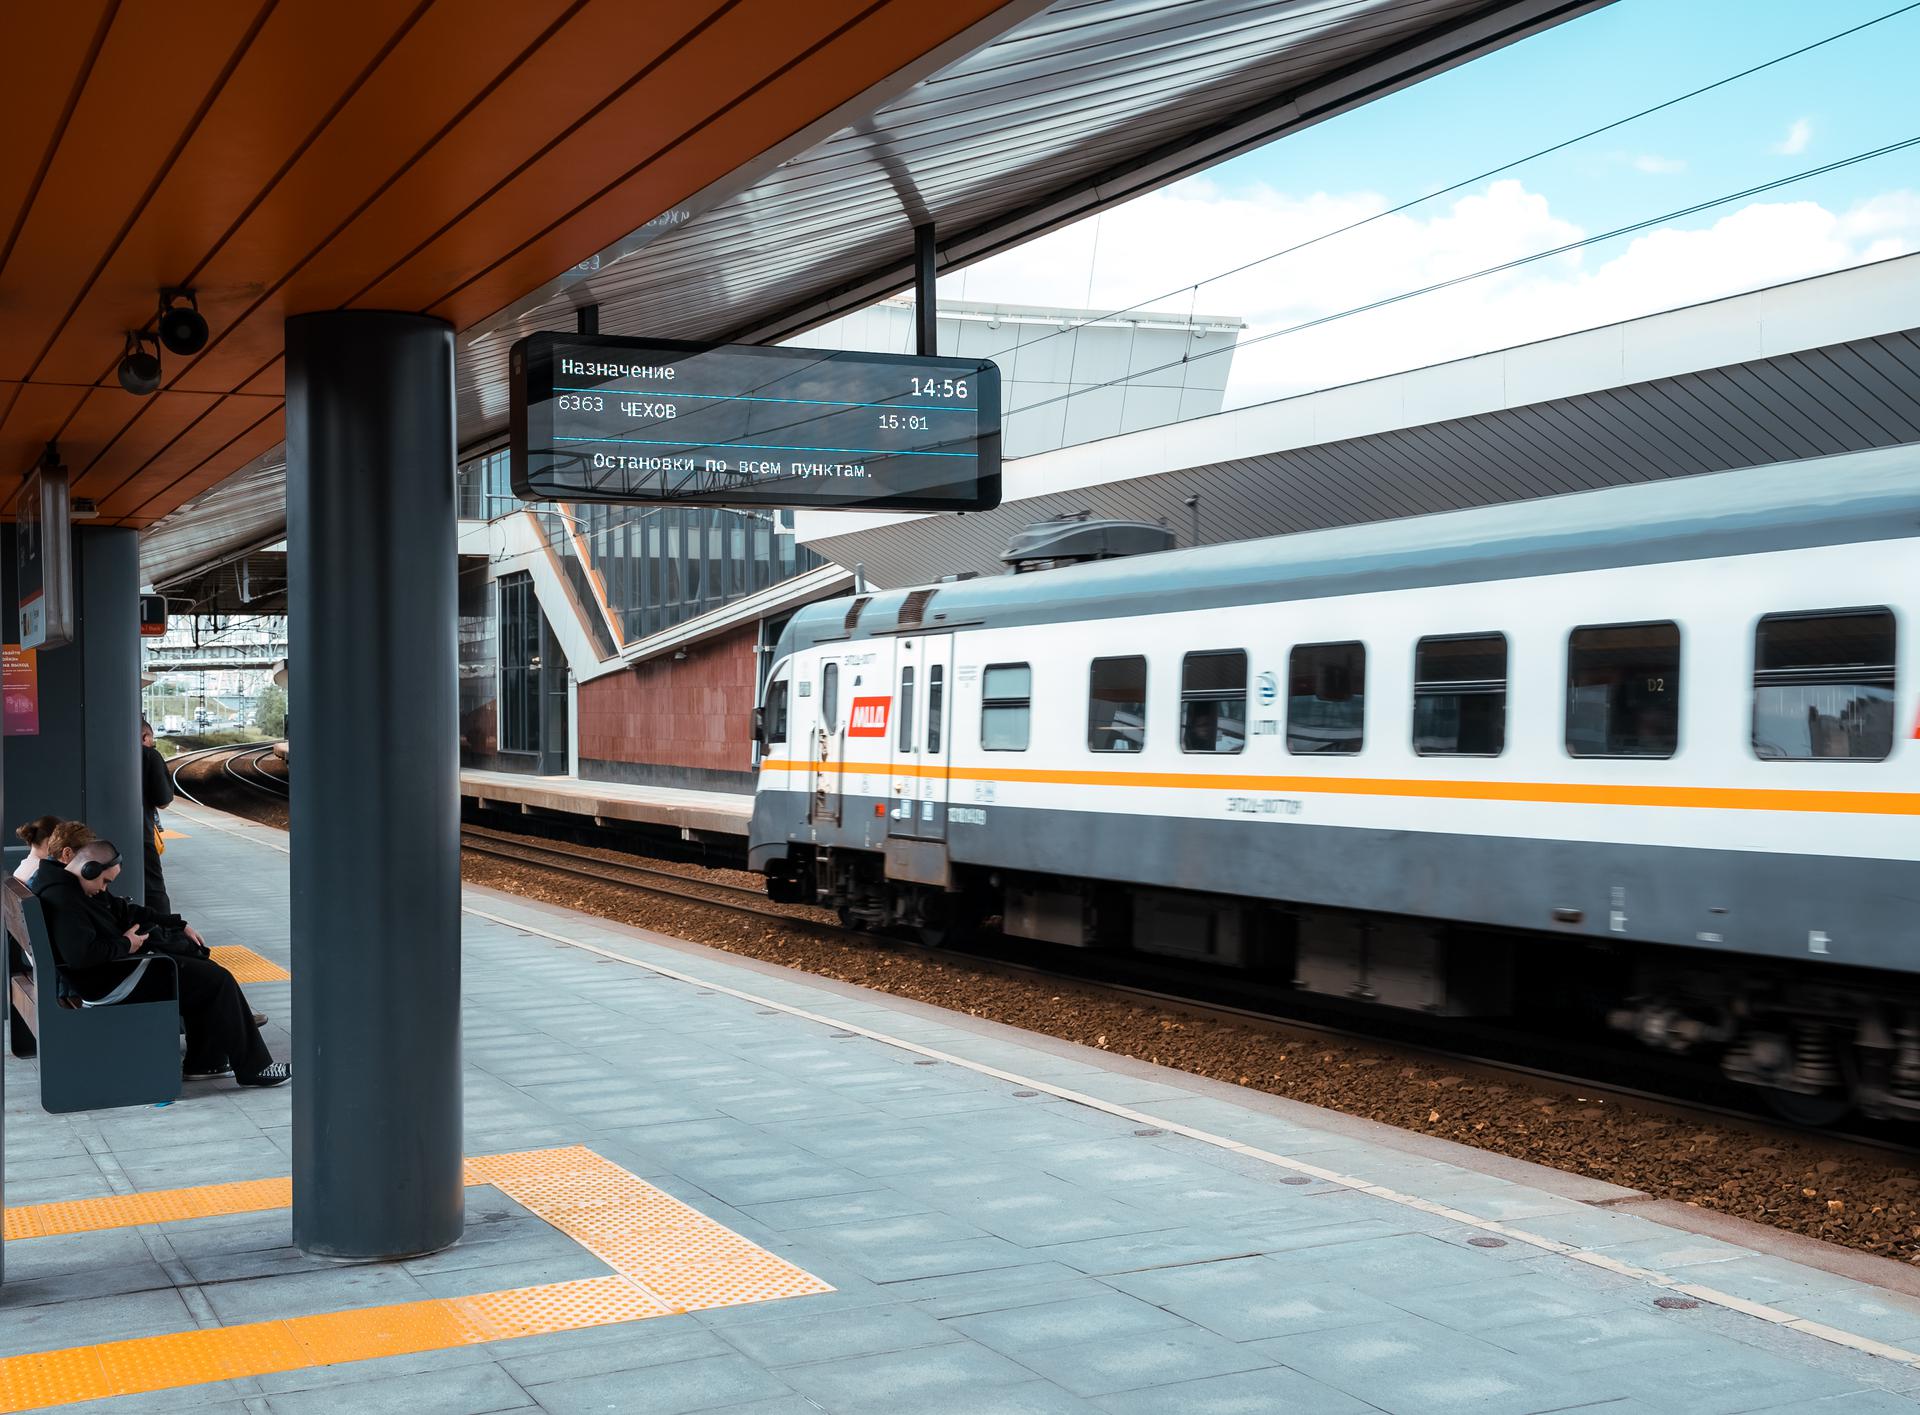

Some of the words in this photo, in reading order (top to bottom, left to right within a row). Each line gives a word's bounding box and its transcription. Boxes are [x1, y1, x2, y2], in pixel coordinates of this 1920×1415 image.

[561, 359, 675, 380] Назначение
[911, 377, 968, 399] 14:56
[559, 395, 604, 412] 6363
[620, 401, 677, 419] ЧЕХОВ
[879, 415, 929, 430] 15:01
[593, 453, 694, 471] Остановки
[705, 459, 727, 473] по
[739, 460, 781, 474] всем
[791, 462, 873, 478] пунктам.
